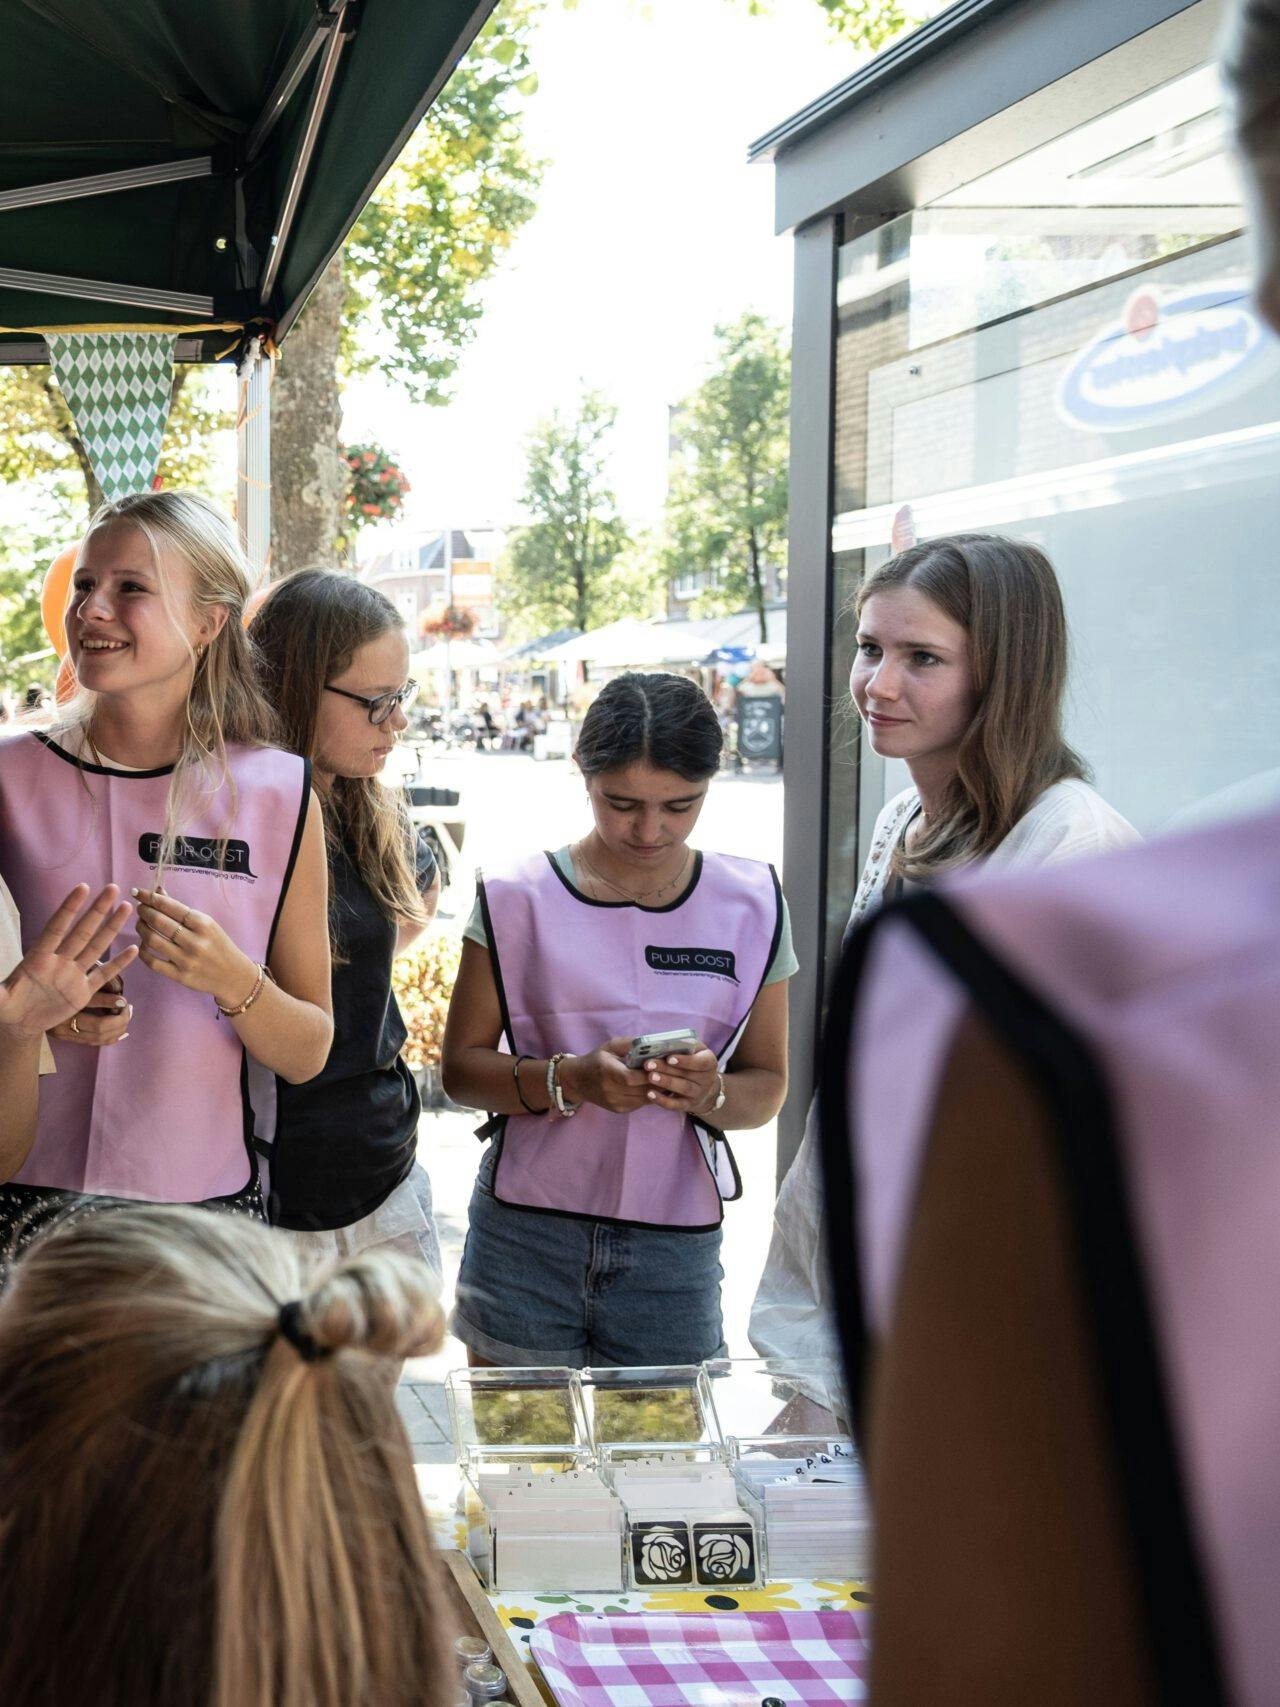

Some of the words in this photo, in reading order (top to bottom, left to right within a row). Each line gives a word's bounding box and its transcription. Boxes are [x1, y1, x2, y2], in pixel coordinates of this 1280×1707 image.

[149, 840, 195, 857] PUR
[651, 952, 690, 964] PUUR
[694, 954, 731, 968] OOST
